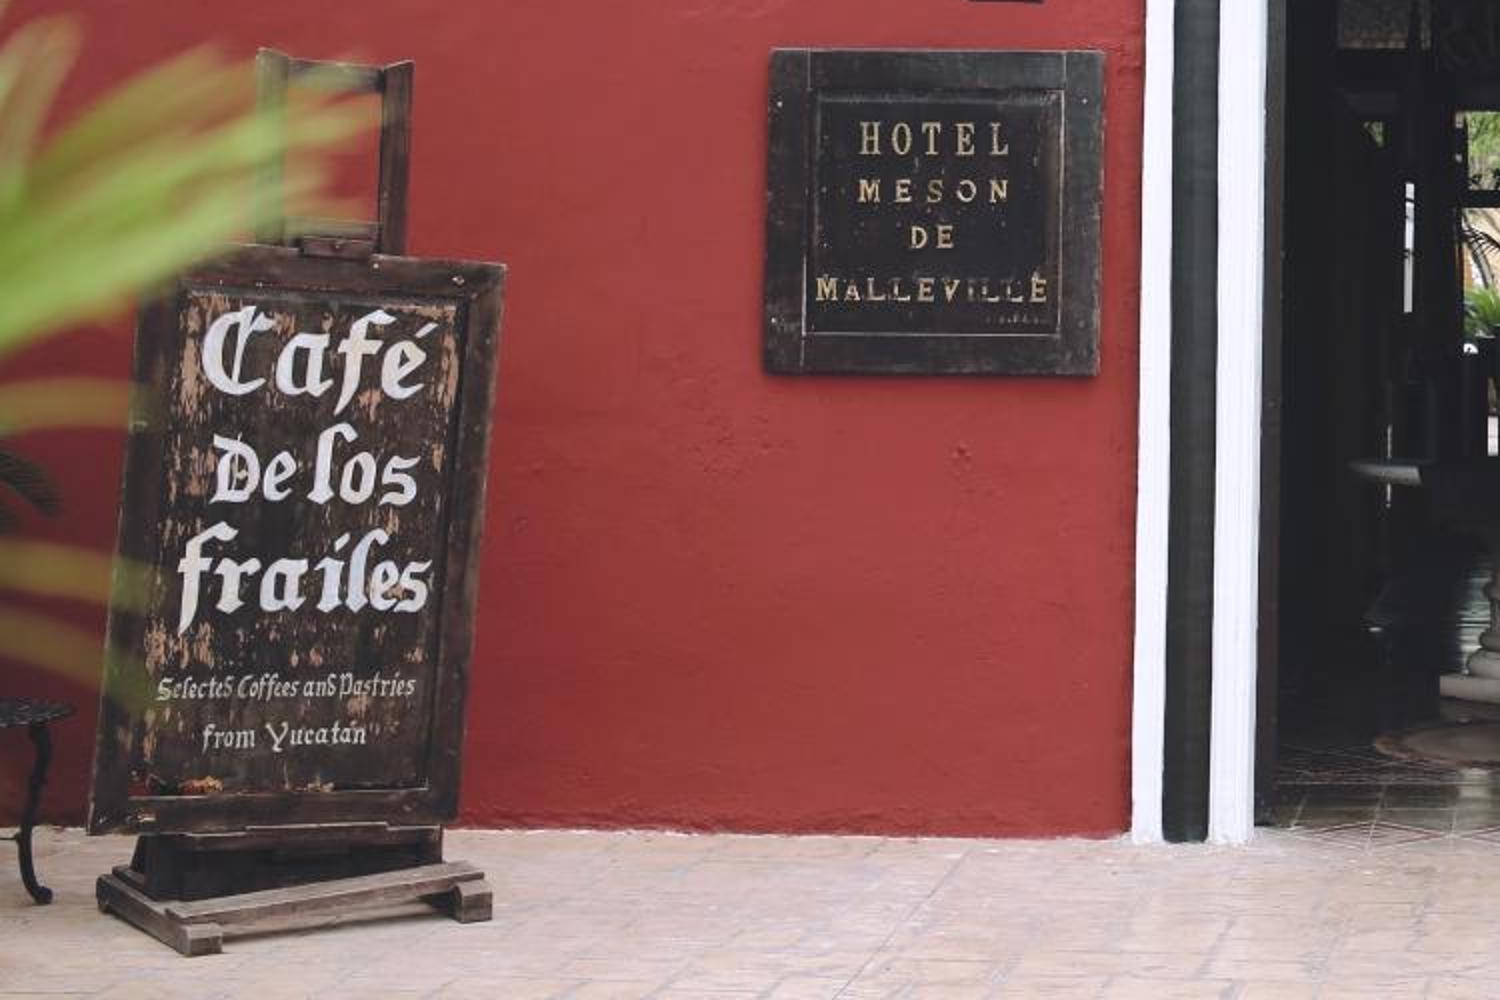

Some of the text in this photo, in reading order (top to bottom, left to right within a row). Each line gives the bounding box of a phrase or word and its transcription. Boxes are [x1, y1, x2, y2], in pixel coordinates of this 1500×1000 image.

[859, 121, 1009, 156] HOTEL
[858, 179, 1009, 203] MESON
[911, 225, 954, 249] DE
[201, 306, 436, 415] Café
[307, 422, 421, 507] los
[238, 673, 300, 701] Coffees
[303, 674, 337, 697] and
[339, 671, 417, 700] Pastries
[202, 723, 255, 754] from
